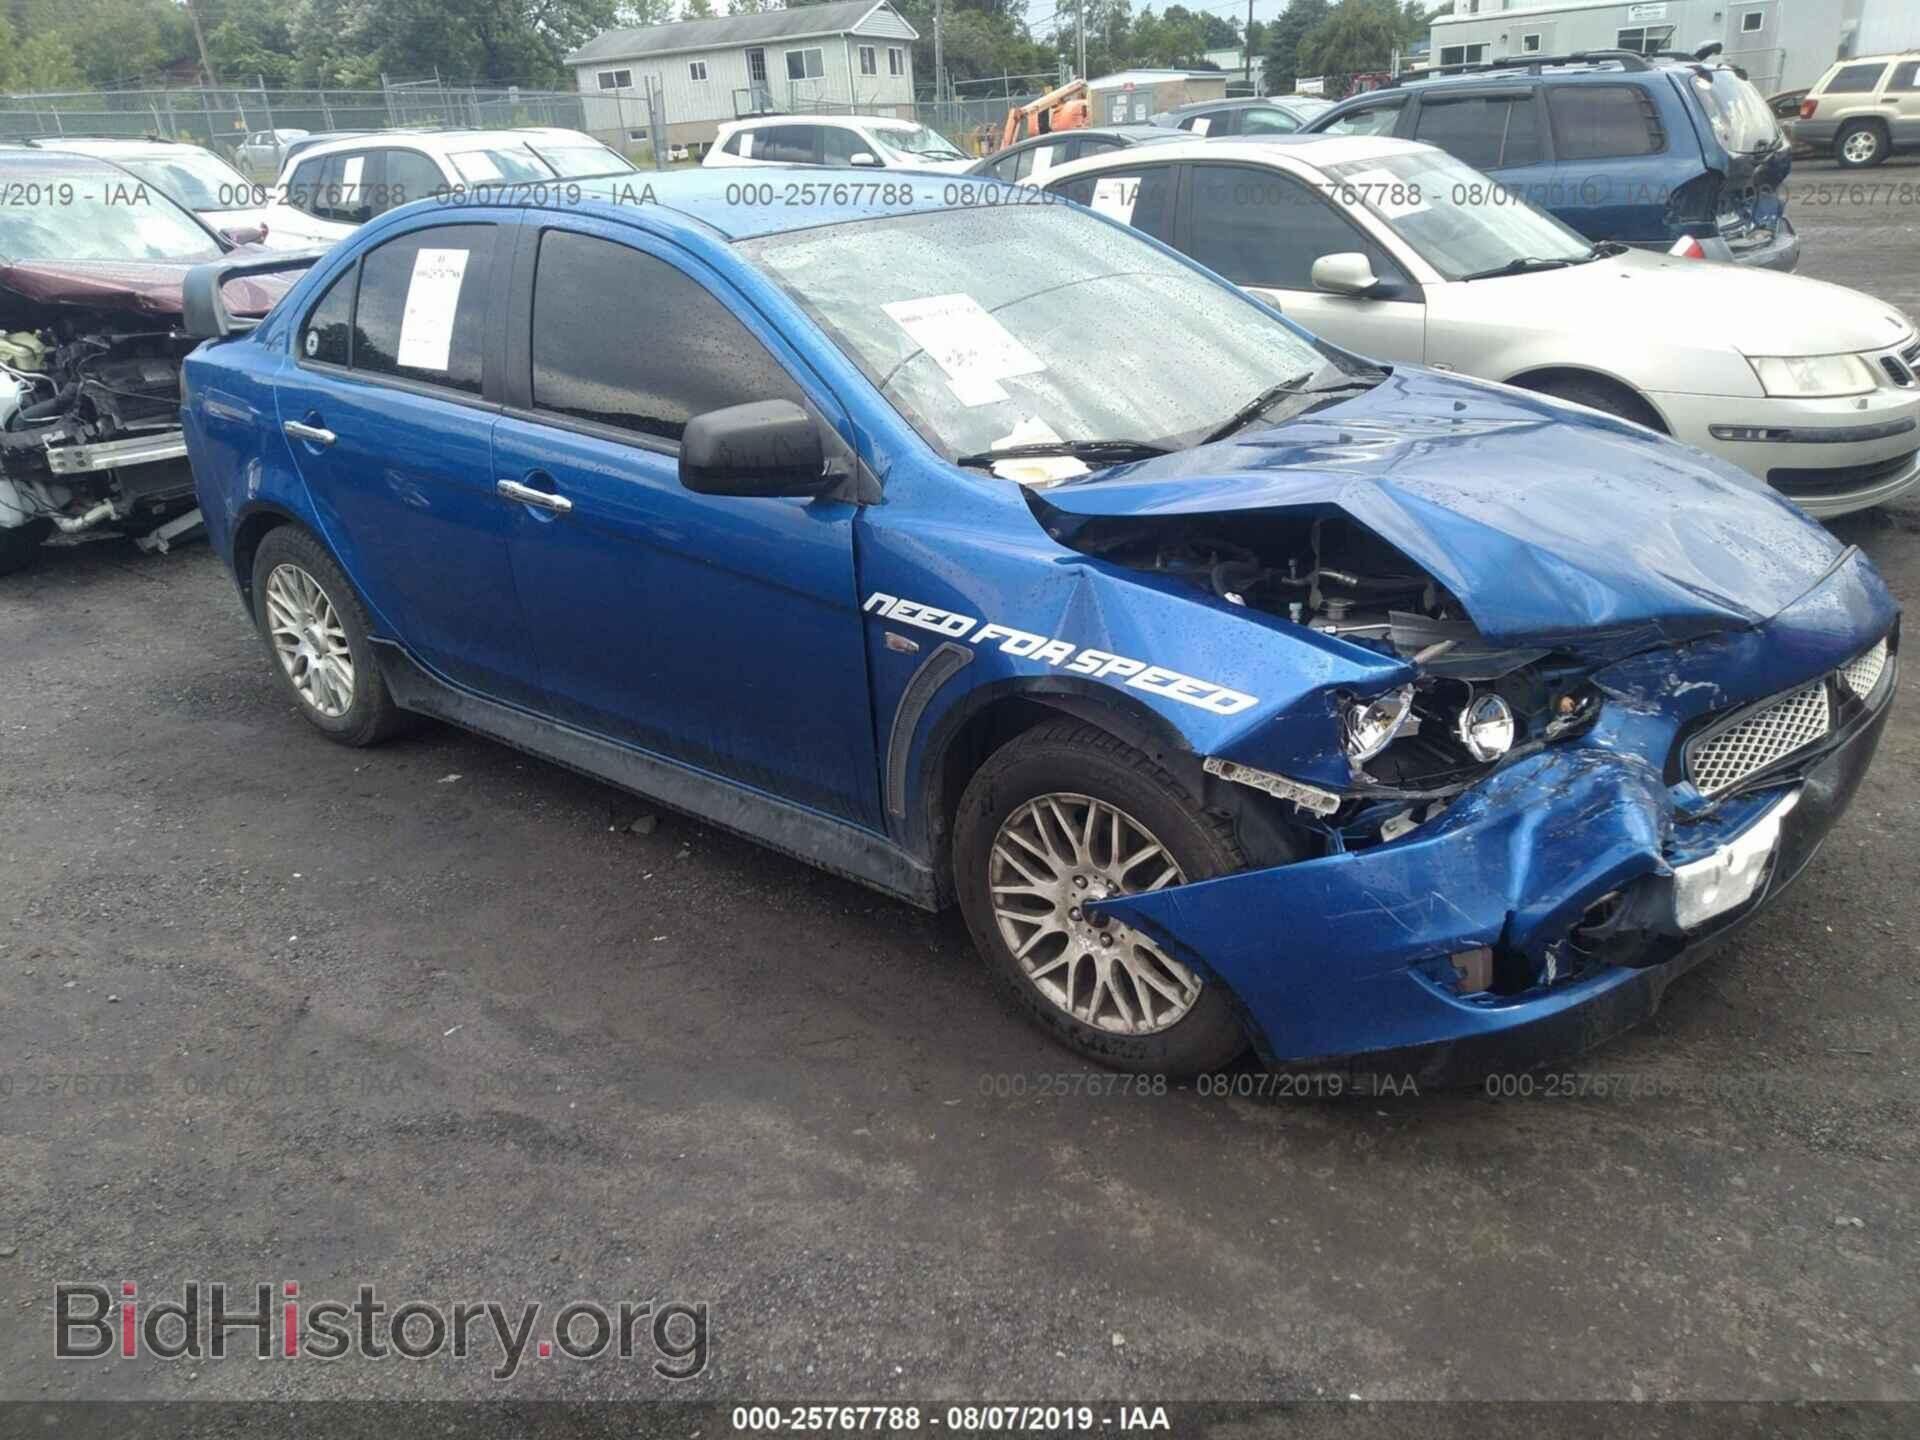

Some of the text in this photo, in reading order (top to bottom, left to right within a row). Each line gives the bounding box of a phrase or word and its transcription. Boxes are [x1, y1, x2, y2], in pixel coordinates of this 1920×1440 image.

[863, 591, 1259, 716] NEED FOR SPEED
